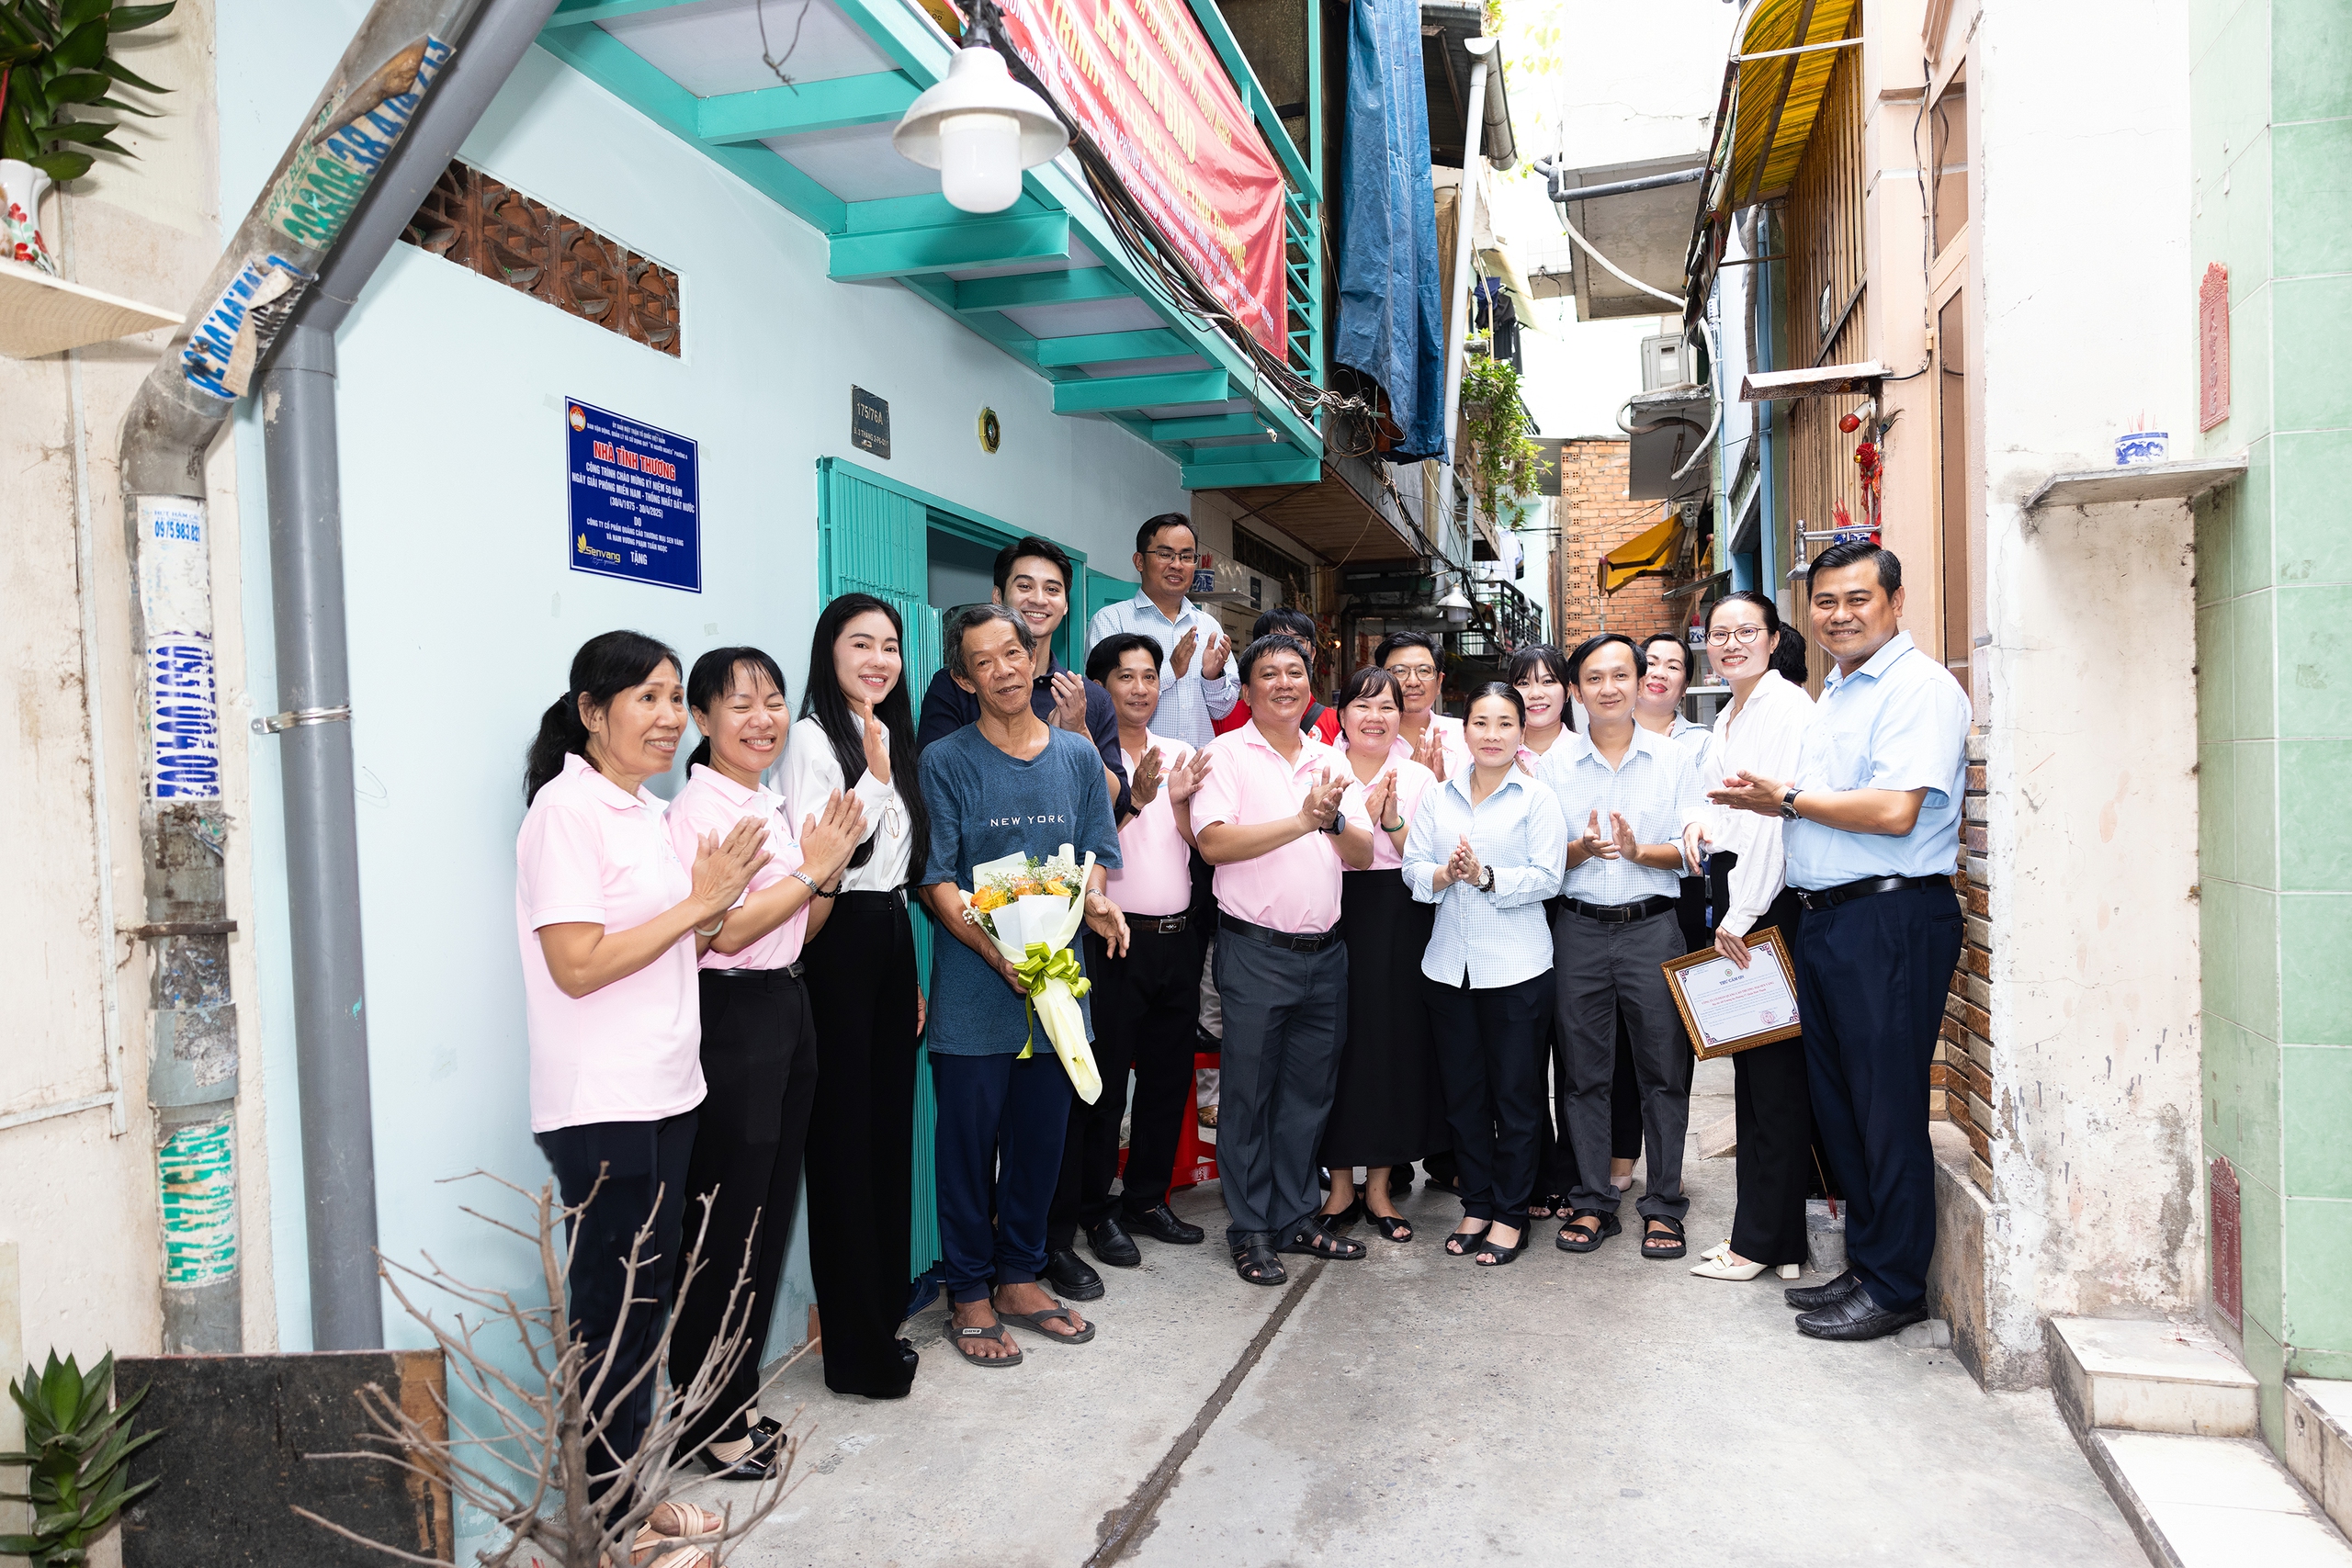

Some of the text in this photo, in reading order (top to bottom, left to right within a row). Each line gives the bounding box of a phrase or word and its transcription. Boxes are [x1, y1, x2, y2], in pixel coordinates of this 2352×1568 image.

[1163, 81, 1196, 165] GIAO
[1118, 130, 1141, 174] PHÓNG
[857, 402, 883, 424] 175/76A
[861, 430, 873, 441] THÁNG
[594, 440, 676, 481] NHÀ TÌNH THƯƠNG
[572, 472, 586, 484] NGÀY
[586, 475, 597, 488] GIẢI
[598, 479, 615, 492] PHÓNG
[616, 484, 629, 495] MIỀN
[630, 488, 641, 500] NAM
[645, 491, 661, 504] THỐNG
[662, 495, 673, 507] NHẤT
[673, 497, 682, 510] ĐẤT
[683, 502, 695, 513] NƯỚC
[586, 462, 683, 497] CÔNG TRÌNH CHÀO MỪNG KỶ NIỆM 50 NĂM
[586, 517, 598, 527] CÔNG
[605, 520, 610, 530] CỔ
[622, 525, 635, 536] QUẢNG
[644, 531, 658, 541] THƯƠNG
[674, 537, 684, 547] VÀNG
[634, 516, 642, 526] DO
[606, 532, 668, 554] VÀ NAM VƯƠNG PHẠM TUẤN NGỌC
[630, 550, 648, 566] TẶNG
[990, 815, 1065, 827] NEW YORK
